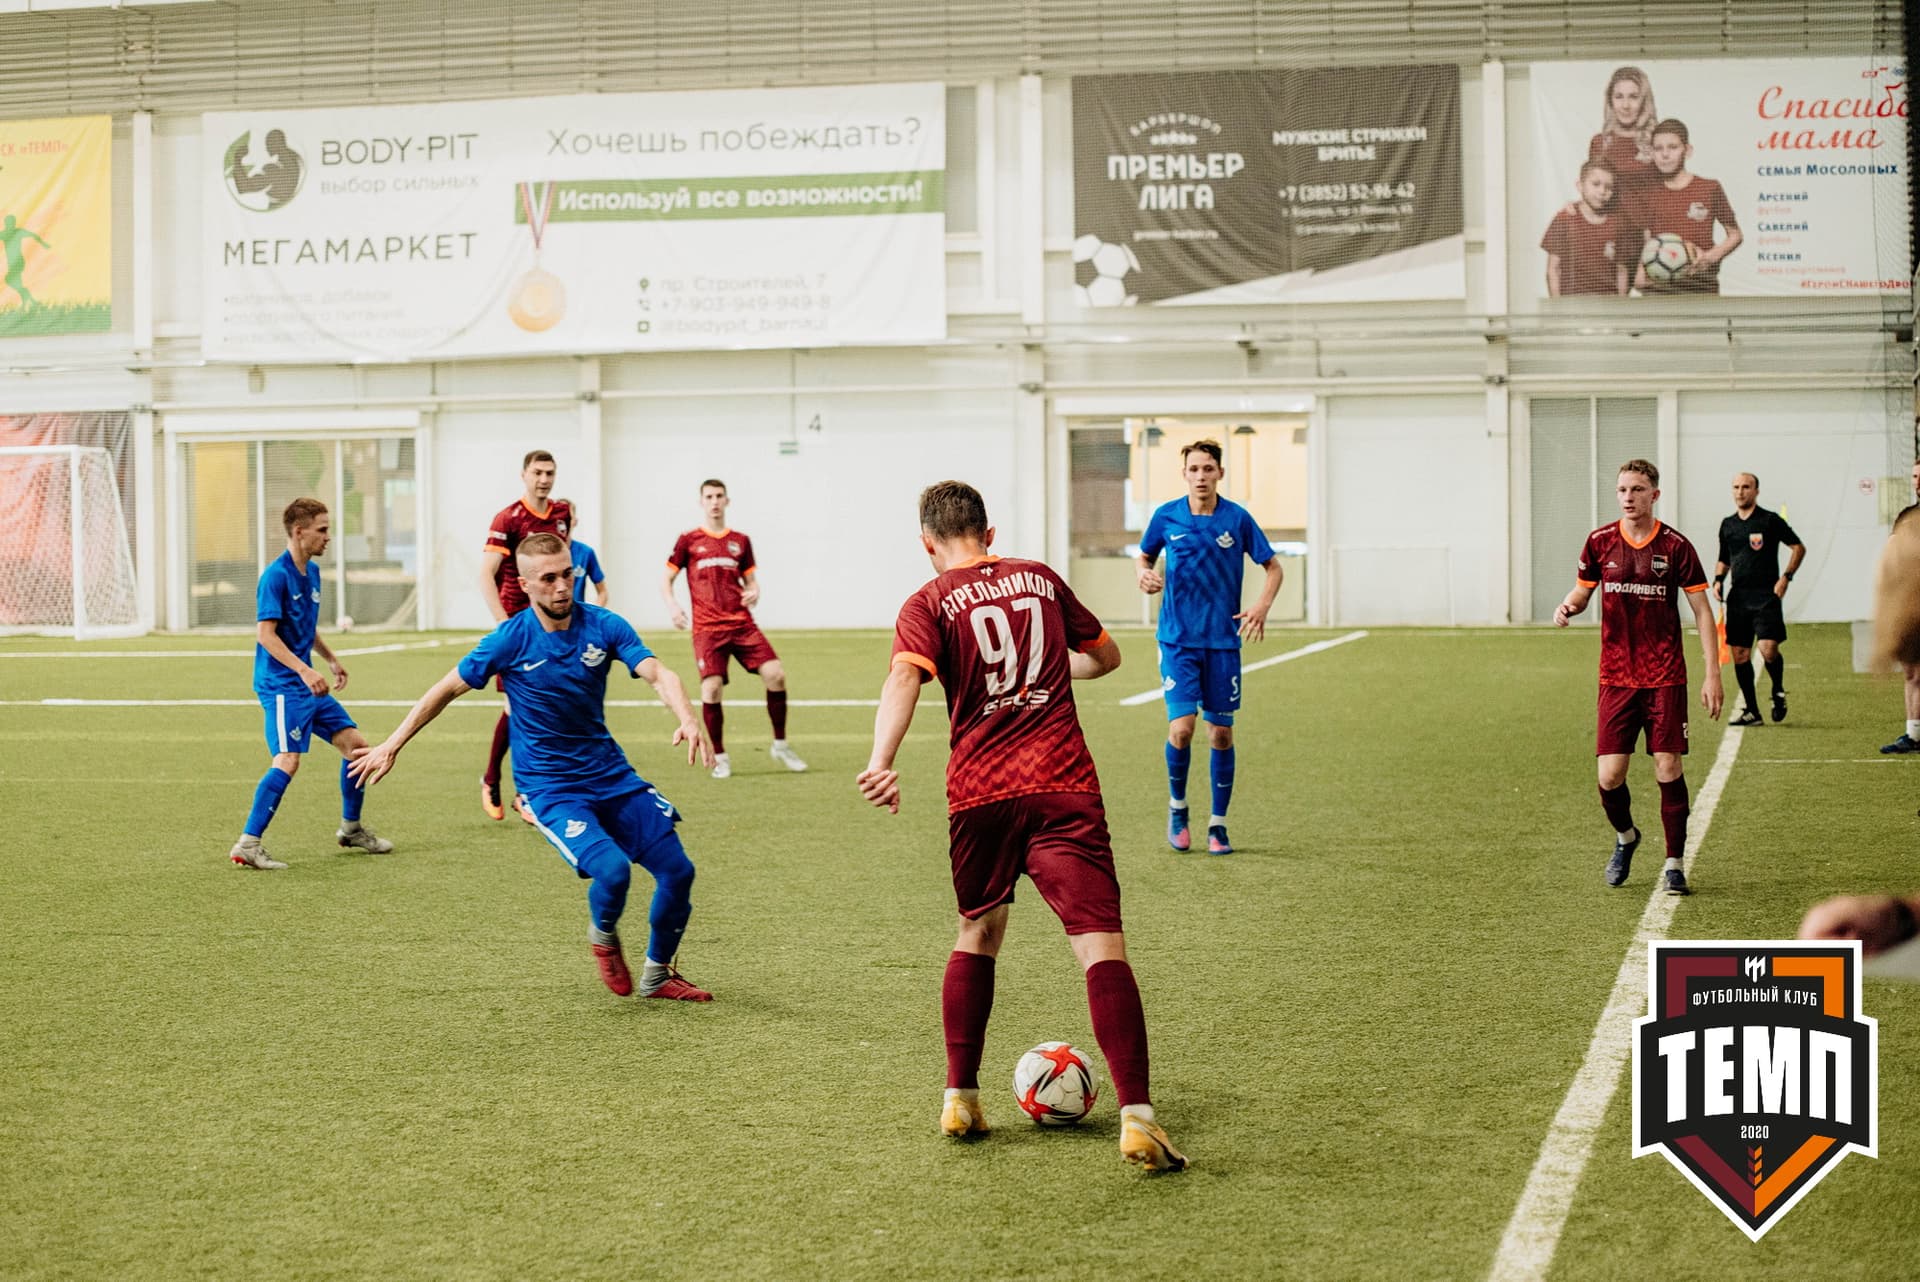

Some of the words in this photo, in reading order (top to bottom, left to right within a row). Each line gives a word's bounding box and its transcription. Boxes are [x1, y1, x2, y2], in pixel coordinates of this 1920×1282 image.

[321, 133, 479, 166] BODY-PIT
[546, 128, 688, 156] Хочешь
[700, 117, 922, 152] побеждать?
[1272, 129, 1350, 145] МУЖСКИЕ
[1351, 126, 1428, 143] СТРИЖКИ
[1757, 128, 1885, 150] мама
[1107, 153, 1245, 180] ПРЕМЬЕР
[1317, 145, 1376, 161] БРИТЬЕ
[320, 176, 387, 194] выбор
[392, 174, 479, 191] сильных
[559, 187, 691, 211] Используй
[697, 187, 740, 208] все
[747, 180, 923, 206] возможности!
[1139, 184, 1214, 210] ЛИГА
[224, 232, 477, 266] МЕГАМАРКЕТ
[941, 571, 1055, 621] СТРЕЛЬНИКОВ
[970, 597, 1044, 696] 97
